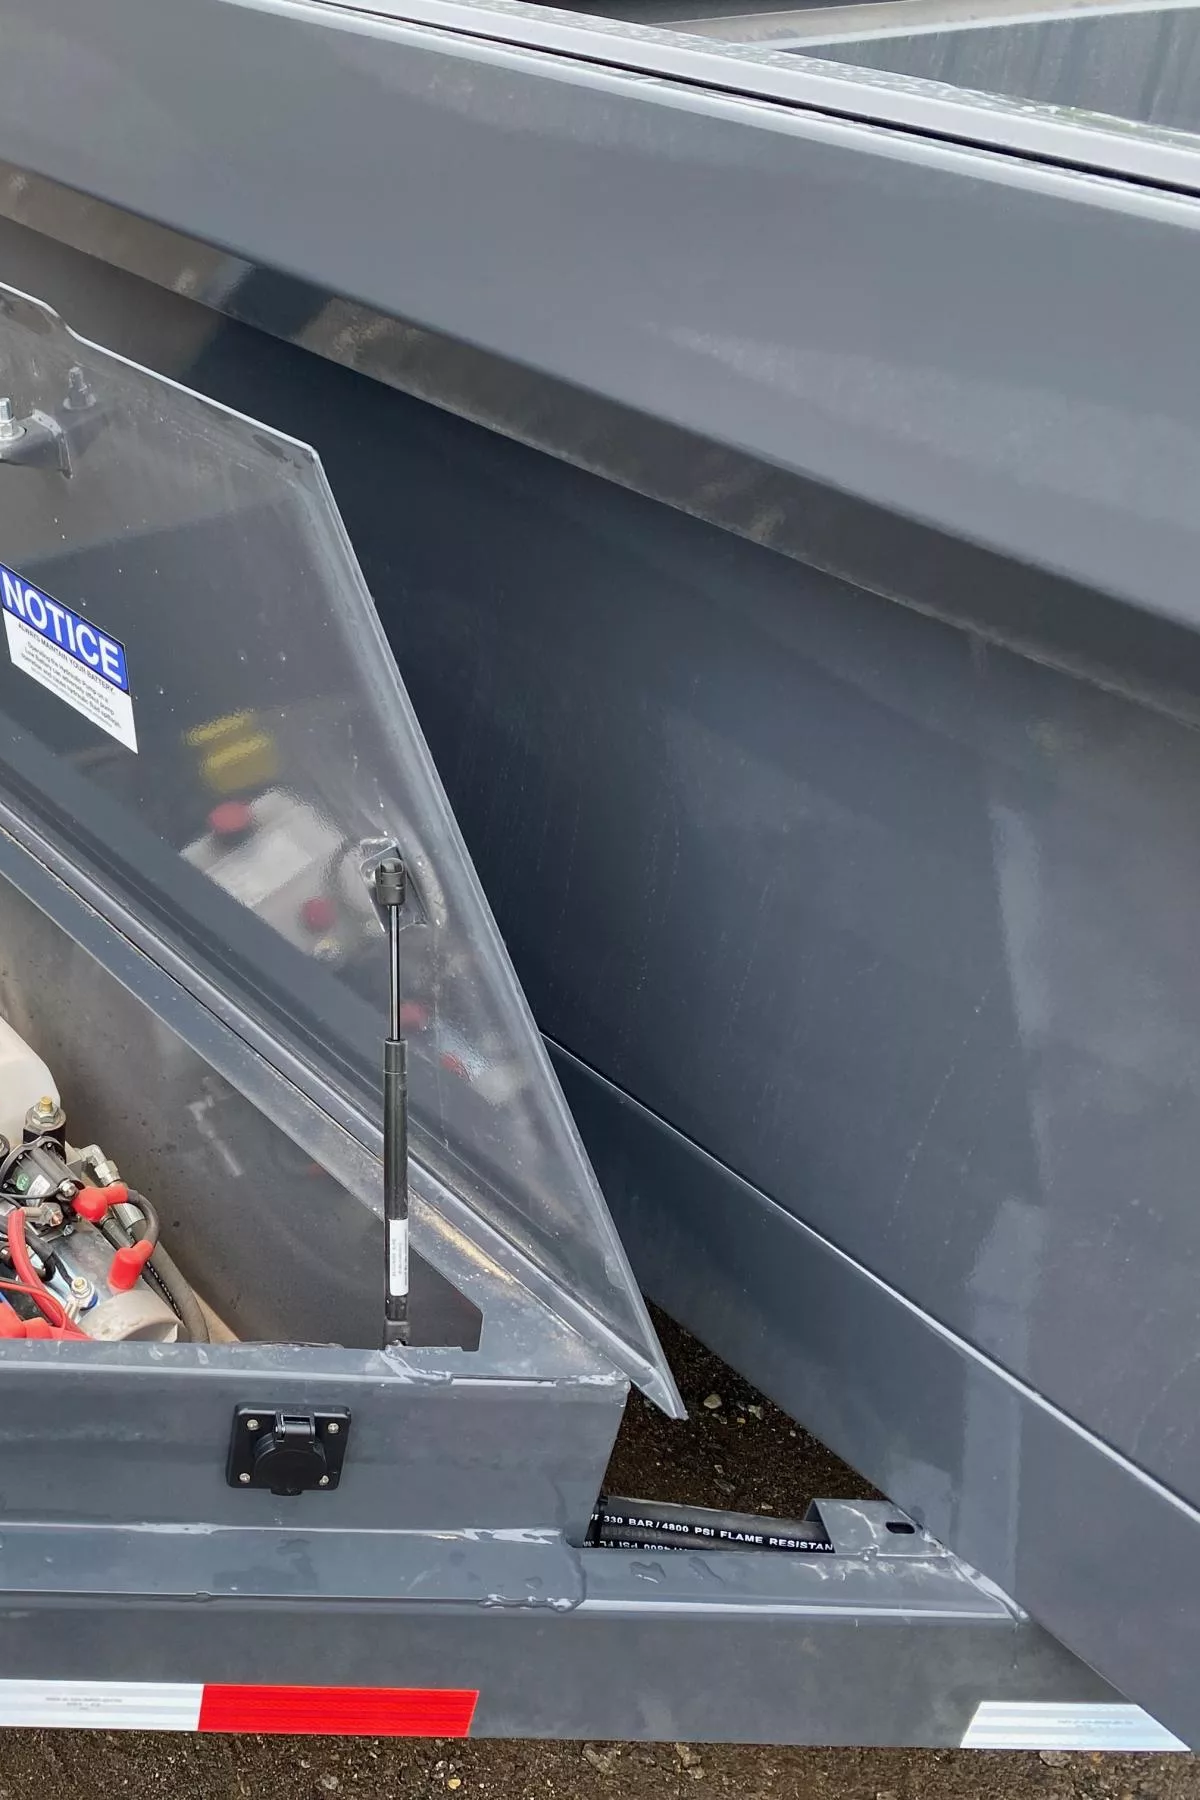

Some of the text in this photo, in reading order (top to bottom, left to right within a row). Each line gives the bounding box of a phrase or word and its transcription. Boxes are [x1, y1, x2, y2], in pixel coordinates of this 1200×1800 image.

[2, 571, 122, 684] NOTICE
[17, 620, 40, 643] ALWAYS
[40, 636, 68, 662] MAINTAIN
[68, 656, 86, 675] YOUR
[603, 1515, 624, 1524] 330
[694, 1526, 715, 1537] PSI
[720, 1530, 763, 1544] FLAME
[769, 1538, 833, 1551] RESISTAN
